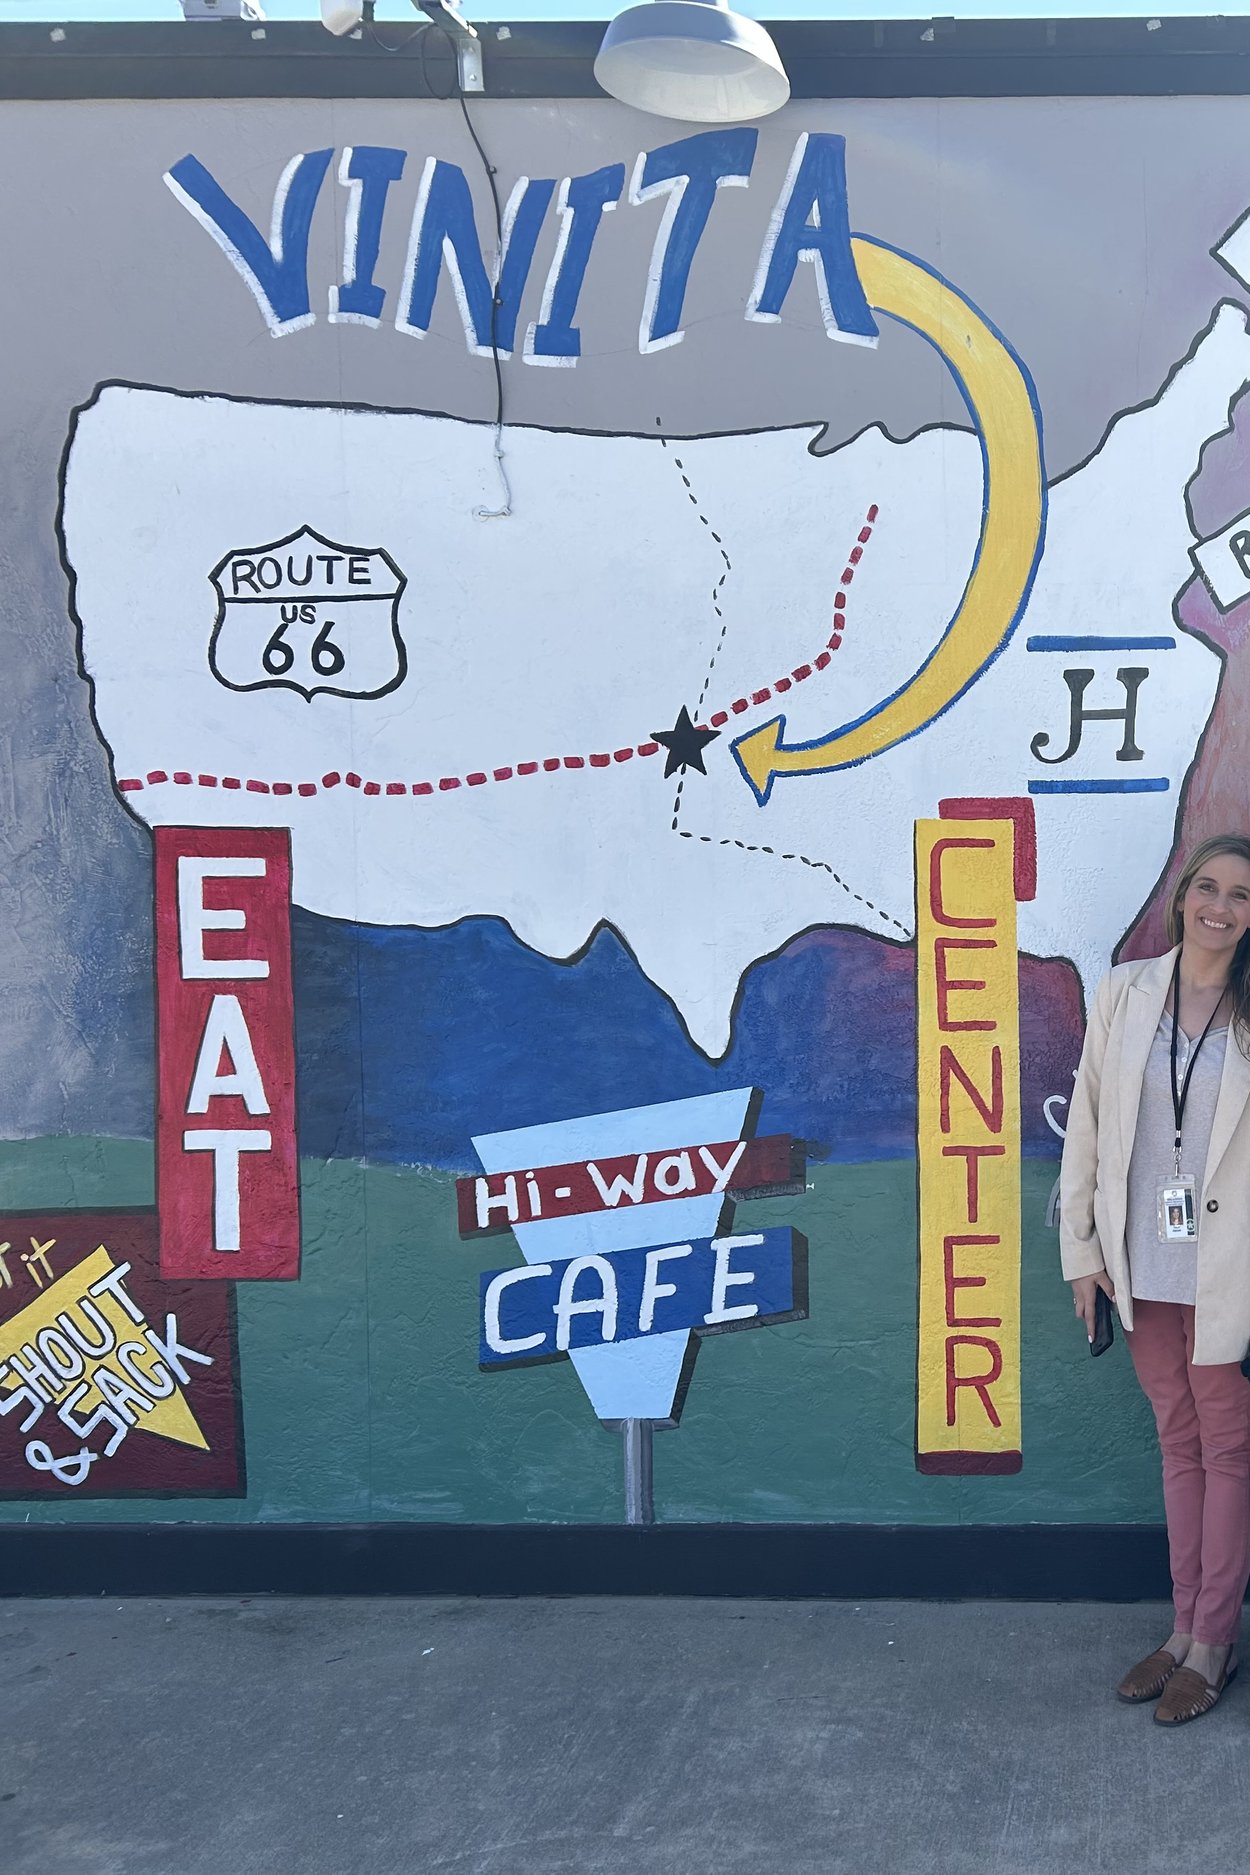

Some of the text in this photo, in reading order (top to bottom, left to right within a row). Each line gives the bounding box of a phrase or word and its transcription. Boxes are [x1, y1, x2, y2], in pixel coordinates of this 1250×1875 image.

[163, 127, 880, 368] VINITA
[231, 554, 372, 595] ROUTE
[280, 604, 316, 625] US
[262, 621, 346, 677] 66
[1030, 667, 1150, 764] JH
[177, 856, 273, 1252] EAT
[929, 837, 1006, 1428] CENTER
[20, 1236, 57, 1289] it
[483, 1234, 765, 1355] CAFE
[0, 1261, 145, 1434] SHOUT
[25, 1313, 215, 1486] & SACK
